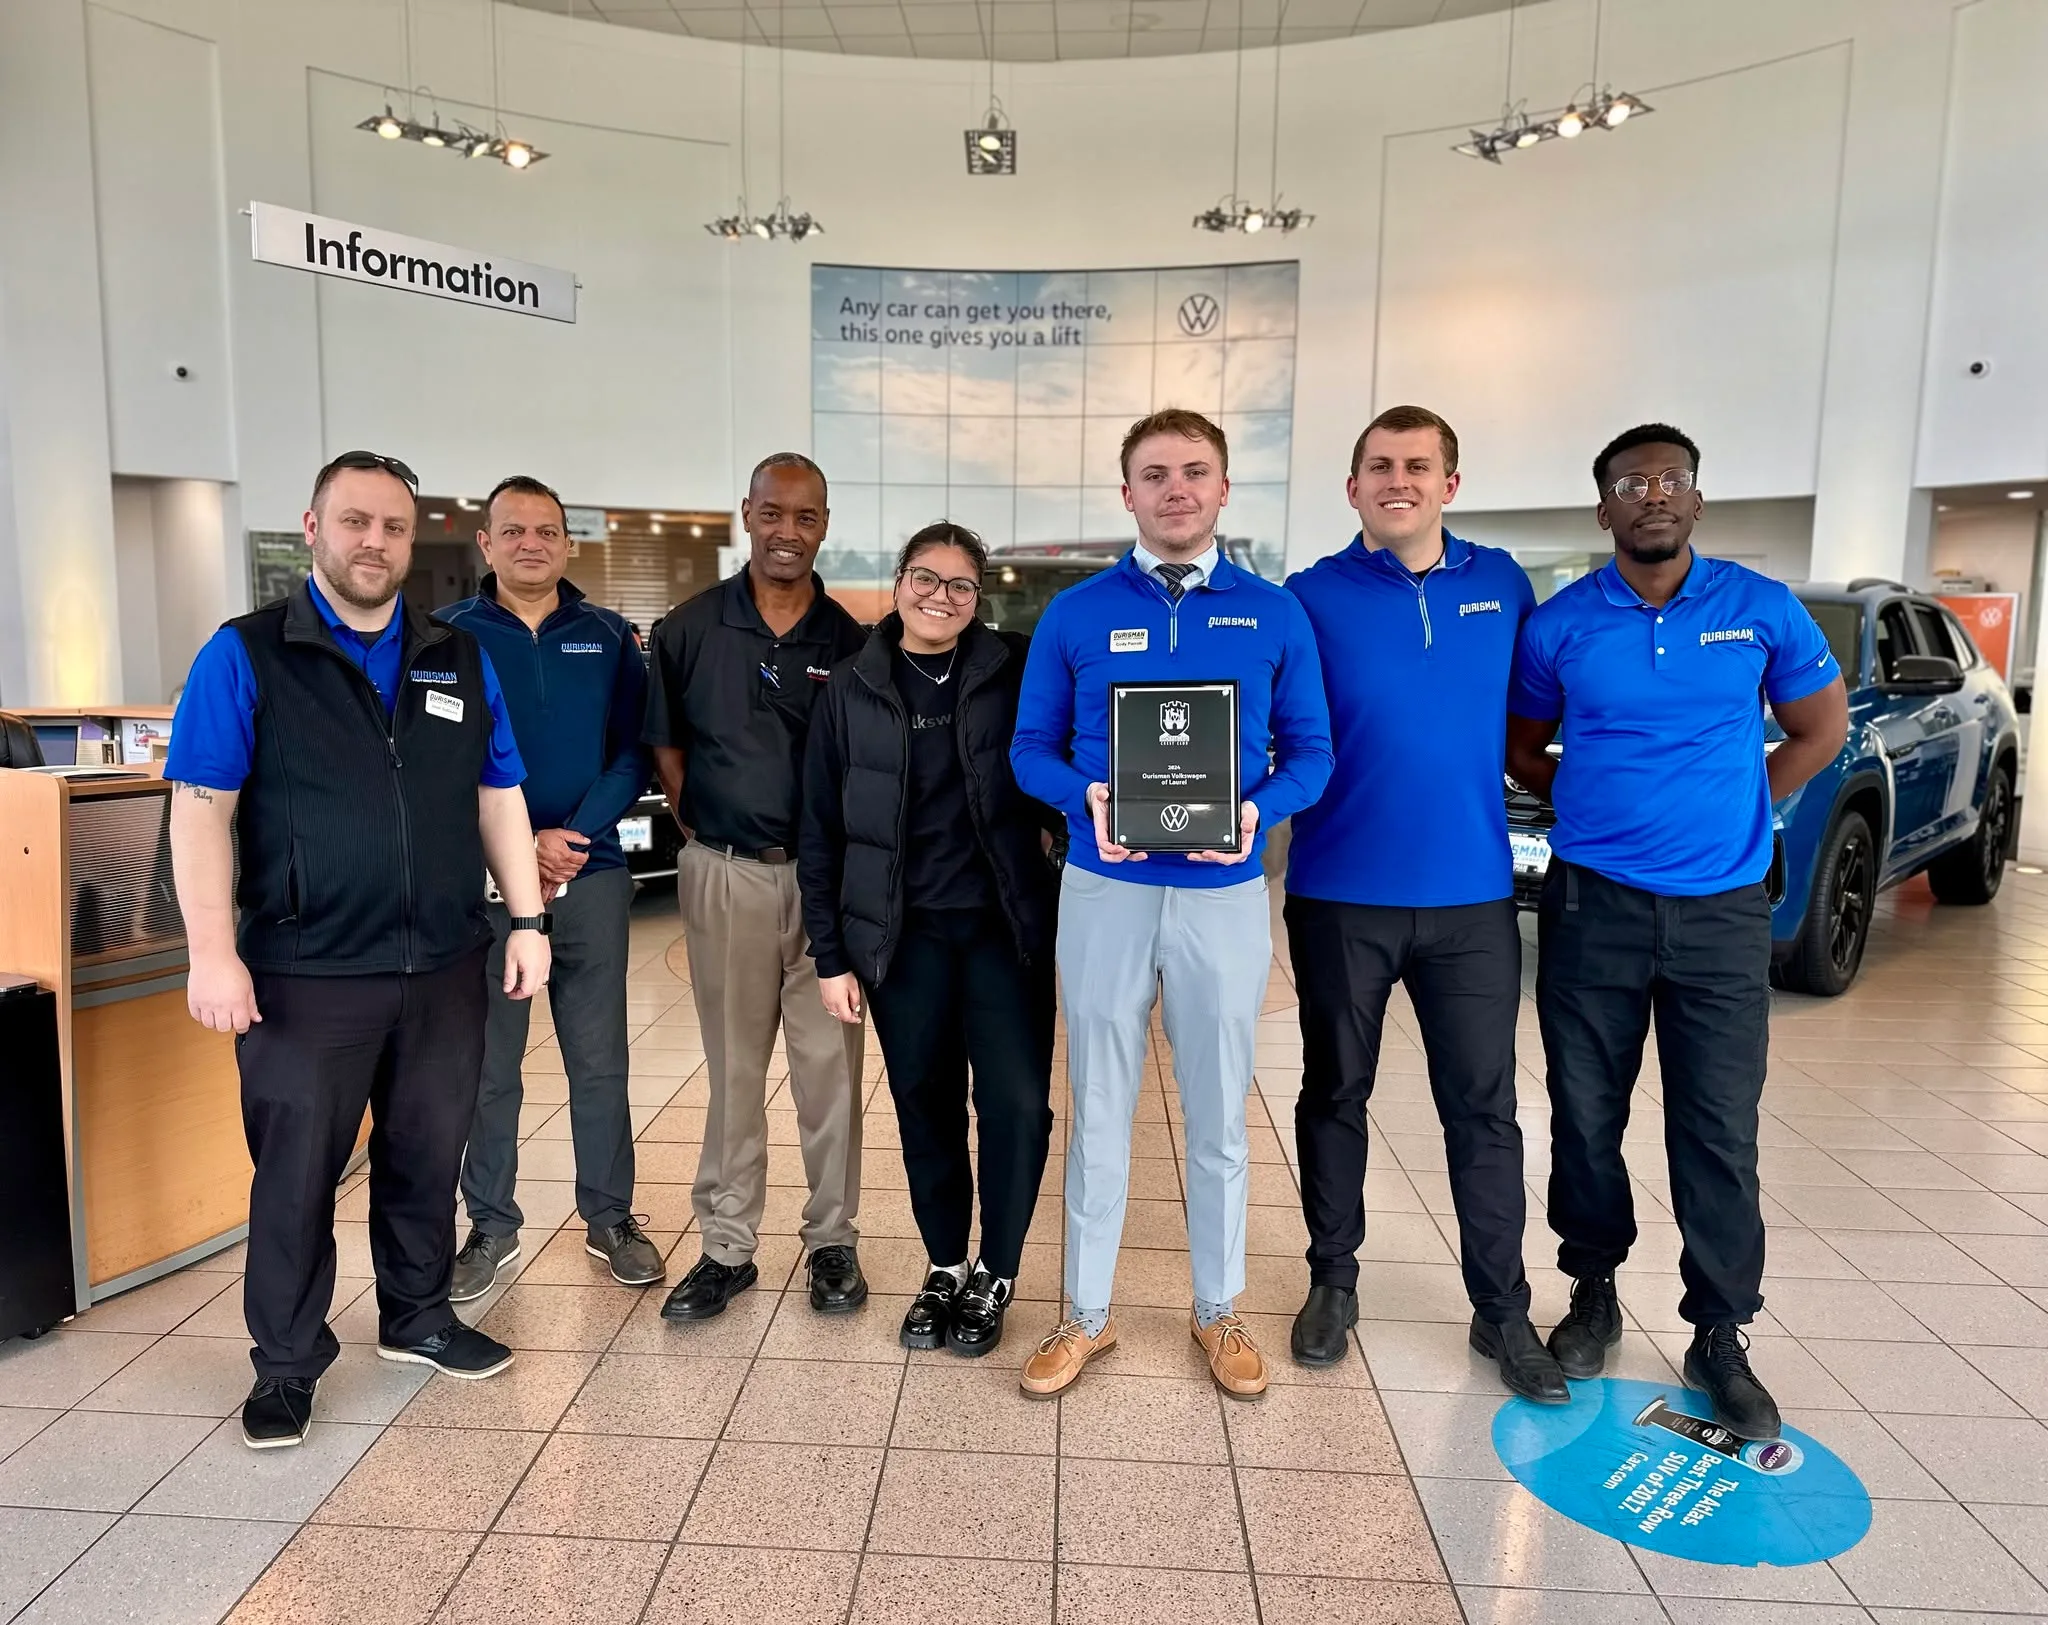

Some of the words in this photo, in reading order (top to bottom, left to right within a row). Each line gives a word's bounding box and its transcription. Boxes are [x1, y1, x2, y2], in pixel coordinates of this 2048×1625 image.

[305, 222, 539, 308] Information
[840, 296, 880, 321] Any
[886, 302, 918, 318] car
[924, 303, 960, 318] can
[966, 303, 1001, 324] get
[1007, 304, 1044, 324] you
[1052, 301, 1112, 322] there,
[840, 322, 879, 342] this
[885, 328, 923, 344] one
[930, 325, 983, 349] gives
[990, 330, 1026, 350] you
[1033, 330, 1045, 346] a
[1052, 325, 1081, 345] lift
[1459, 600, 1501, 616] OURISMAN
[1208, 616, 1257, 629] OURISMAN
[1113, 631, 1146, 640] OURISMAN
[1700, 628, 1754, 646] OURISMAN
[561, 642, 603, 650] OURISMAN
[410, 670, 458, 681] OURISMAN
[430, 693, 461, 708] OURISMAN
[1171, 772, 1207, 780] Volkswagen
[1602, 1452, 1649, 1490] Cars.com
[1658, 1451, 1688, 1477] SUV
[1687, 1453, 1722, 1478] Best
[1645, 1472, 1664, 1489] of
[1707, 1477, 1740, 1498] The
[1617, 1483, 1658, 1514] 2017.
[1638, 1476, 1704, 1534] Three-Row
